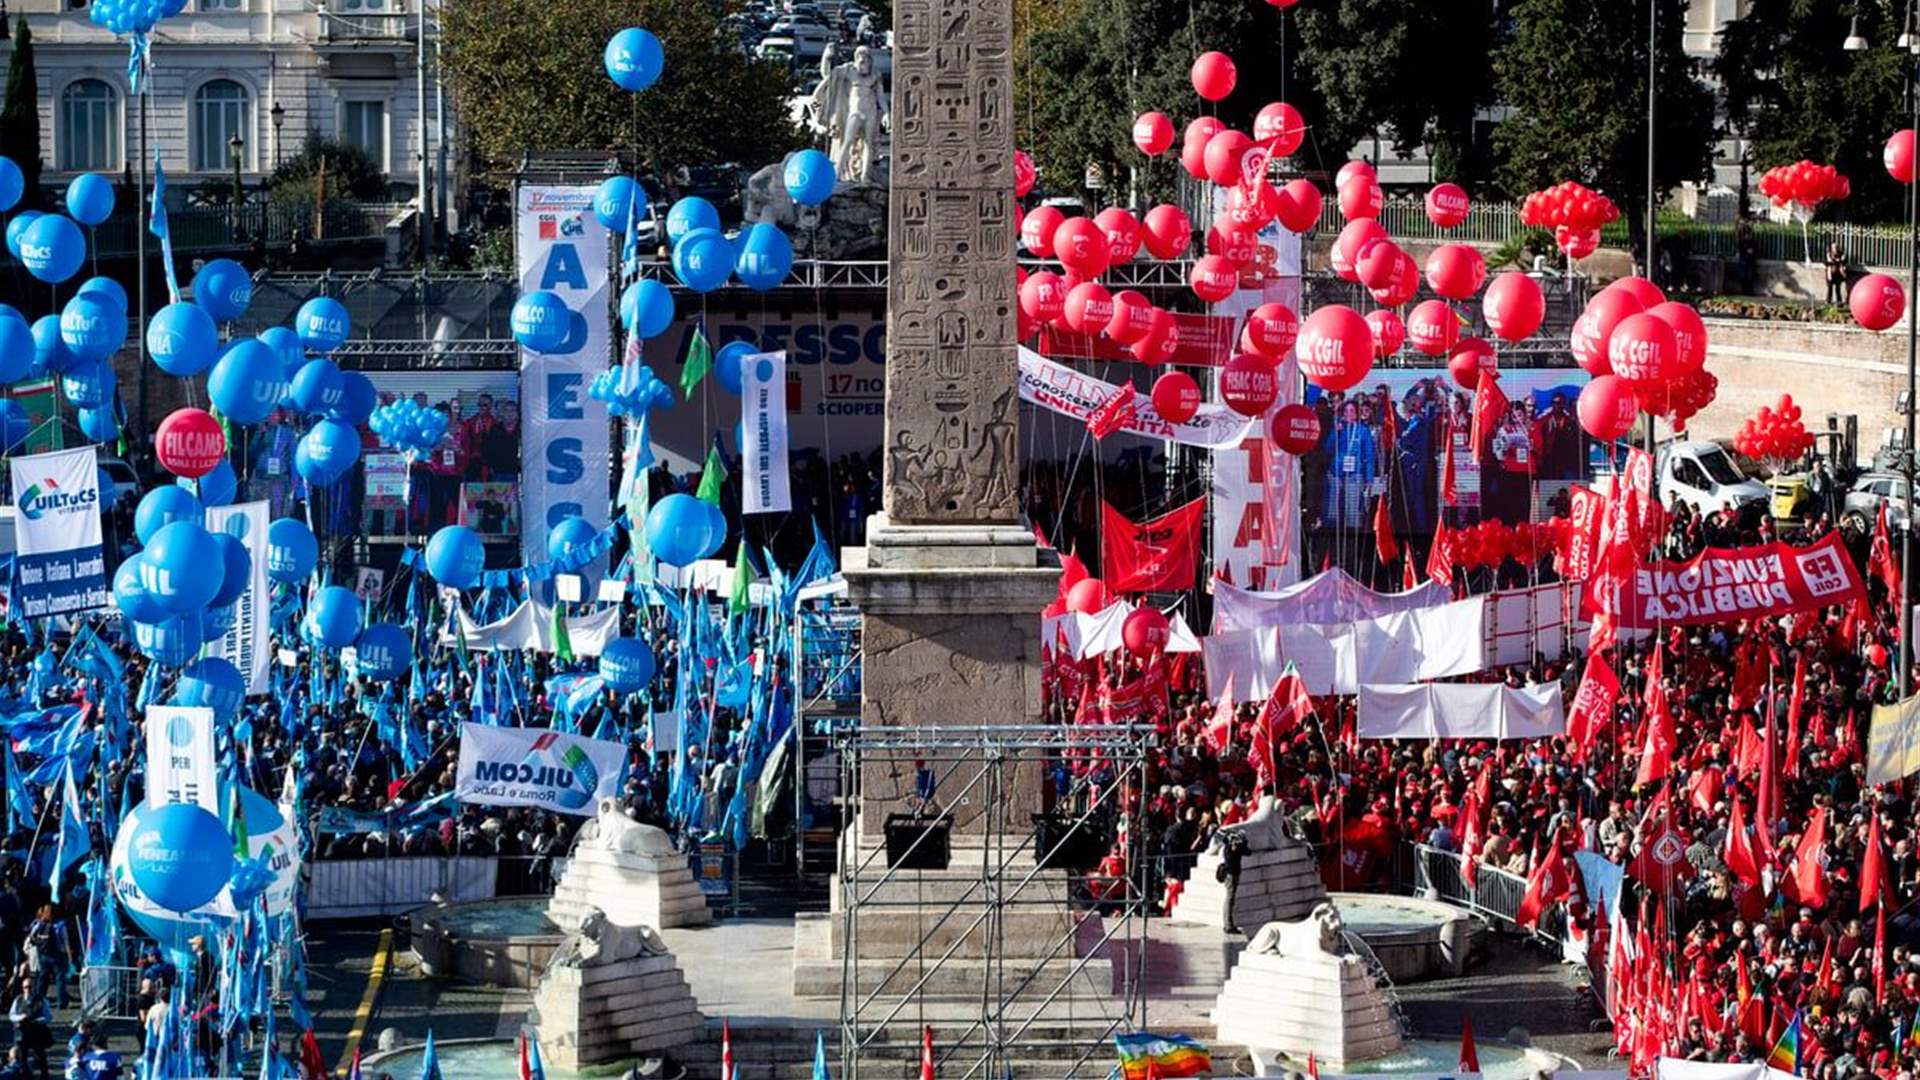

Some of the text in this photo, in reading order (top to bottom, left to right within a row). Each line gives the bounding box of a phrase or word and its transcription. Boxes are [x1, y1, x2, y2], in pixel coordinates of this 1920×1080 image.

[1315, 335, 1345, 365] CGIL
[1629, 338, 1662, 365] CGIL
[828, 374, 853, 394] 17
[165, 432, 222, 456] FILCAMS
[35, 487, 97, 511] UILTuCS
[171, 756, 191, 770] PER
[271, 852, 292, 871] UIL
